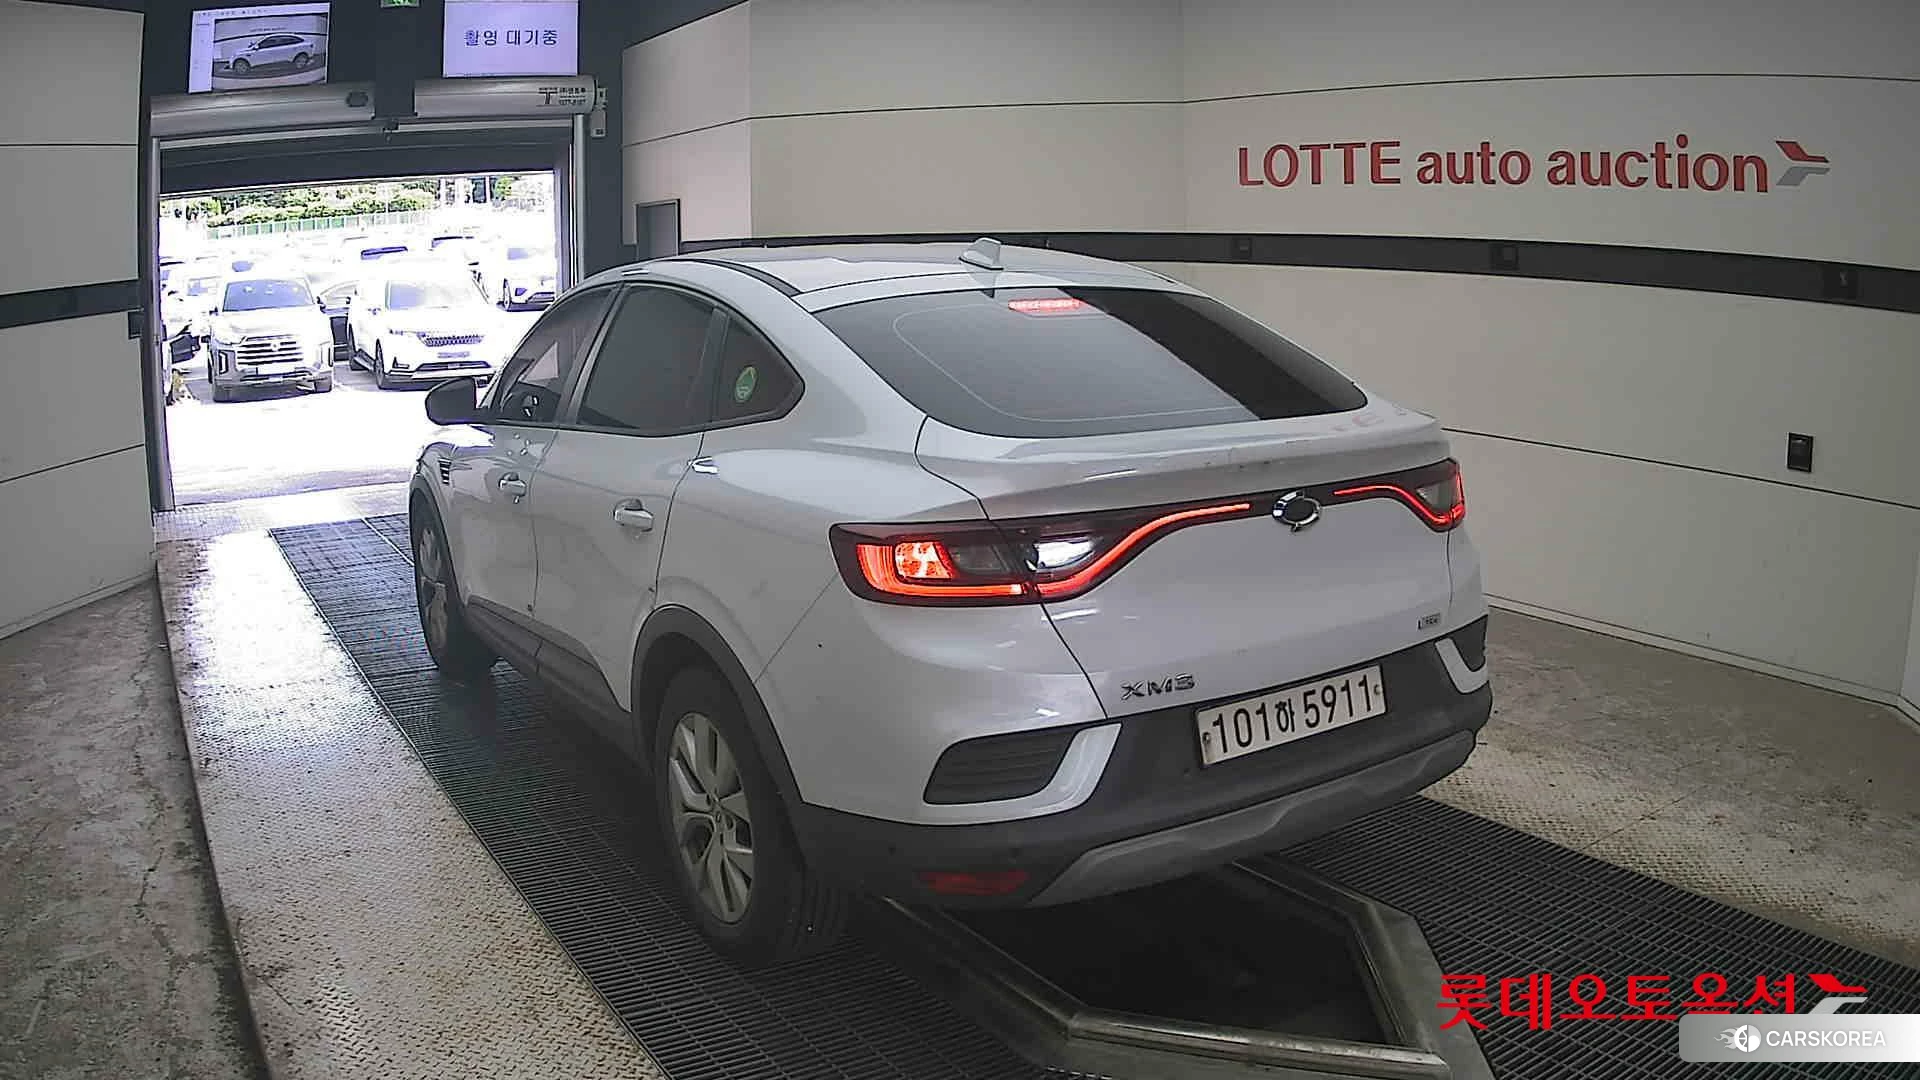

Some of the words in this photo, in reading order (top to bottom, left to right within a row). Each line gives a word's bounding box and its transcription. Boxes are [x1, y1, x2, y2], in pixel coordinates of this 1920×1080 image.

[464, 29, 497, 46] 촬영
[506, 29, 558, 46] 대기중
[1239, 141, 1400, 187] LOTTE
[1416, 141, 1530, 185] auto
[1547, 134, 1768, 193] auction
[1121, 673, 1195, 701] XM3
